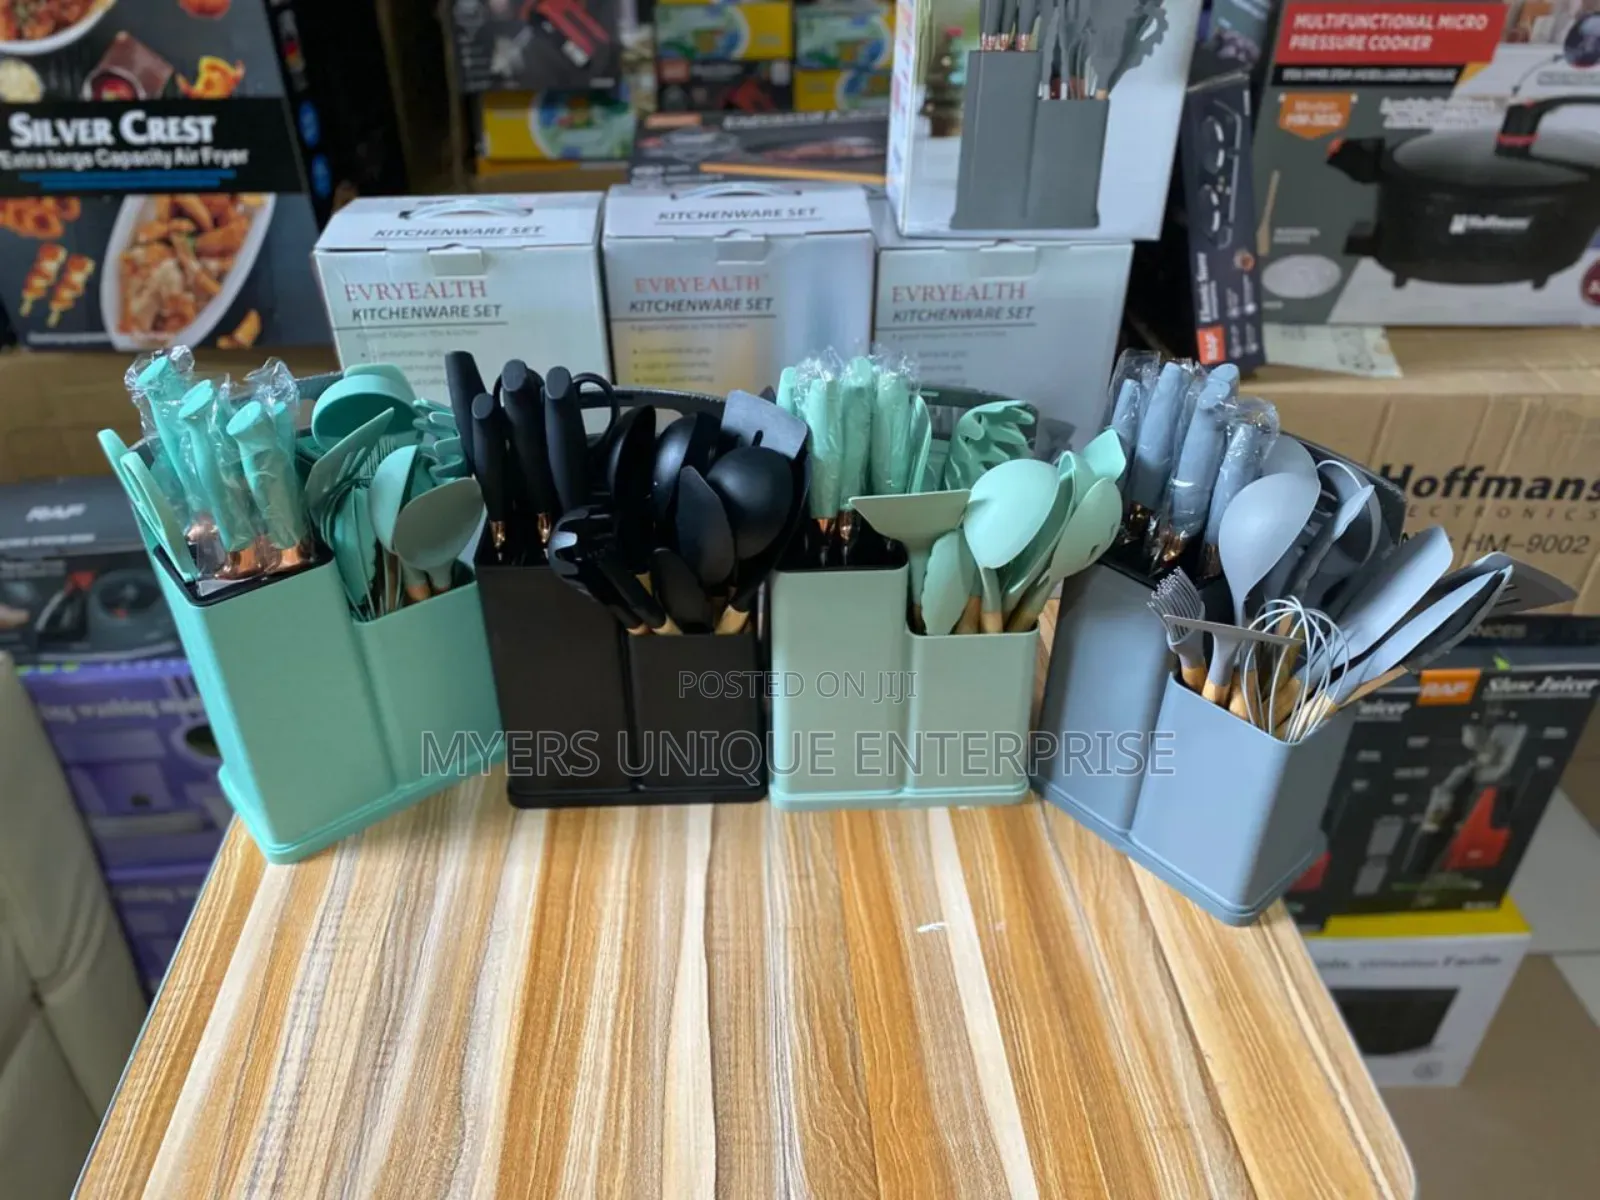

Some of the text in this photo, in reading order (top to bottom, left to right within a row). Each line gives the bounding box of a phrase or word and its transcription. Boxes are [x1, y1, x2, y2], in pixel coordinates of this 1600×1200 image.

[1293, 13, 1489, 30] MULTIFUNCTIONAL MICRO
[1289, 34, 1433, 50] PRESSURE COOKER
[95, 148, 172, 169] Capacity
[174, 147, 200, 166] Air
[657, 206, 818, 221] KITCHENWARE SET
[374, 225, 545, 238] KITCHENWARE SET
[344, 279, 488, 302] EVRYEALTH
[634, 275, 761, 294] EVRYEALTH
[892, 282, 1027, 304] EVRYEALTH
[352, 304, 503, 321] KITCHENWARE SET
[629, 297, 775, 314] KITCHENWARE SET
[892, 305, 1035, 323] KITCHENWARE SET
[1379, 463, 1600, 501] Hoffmans
[1406, 503, 1599, 521] ECTRONICS
[1462, 533, 1590, 554] HM-9002
